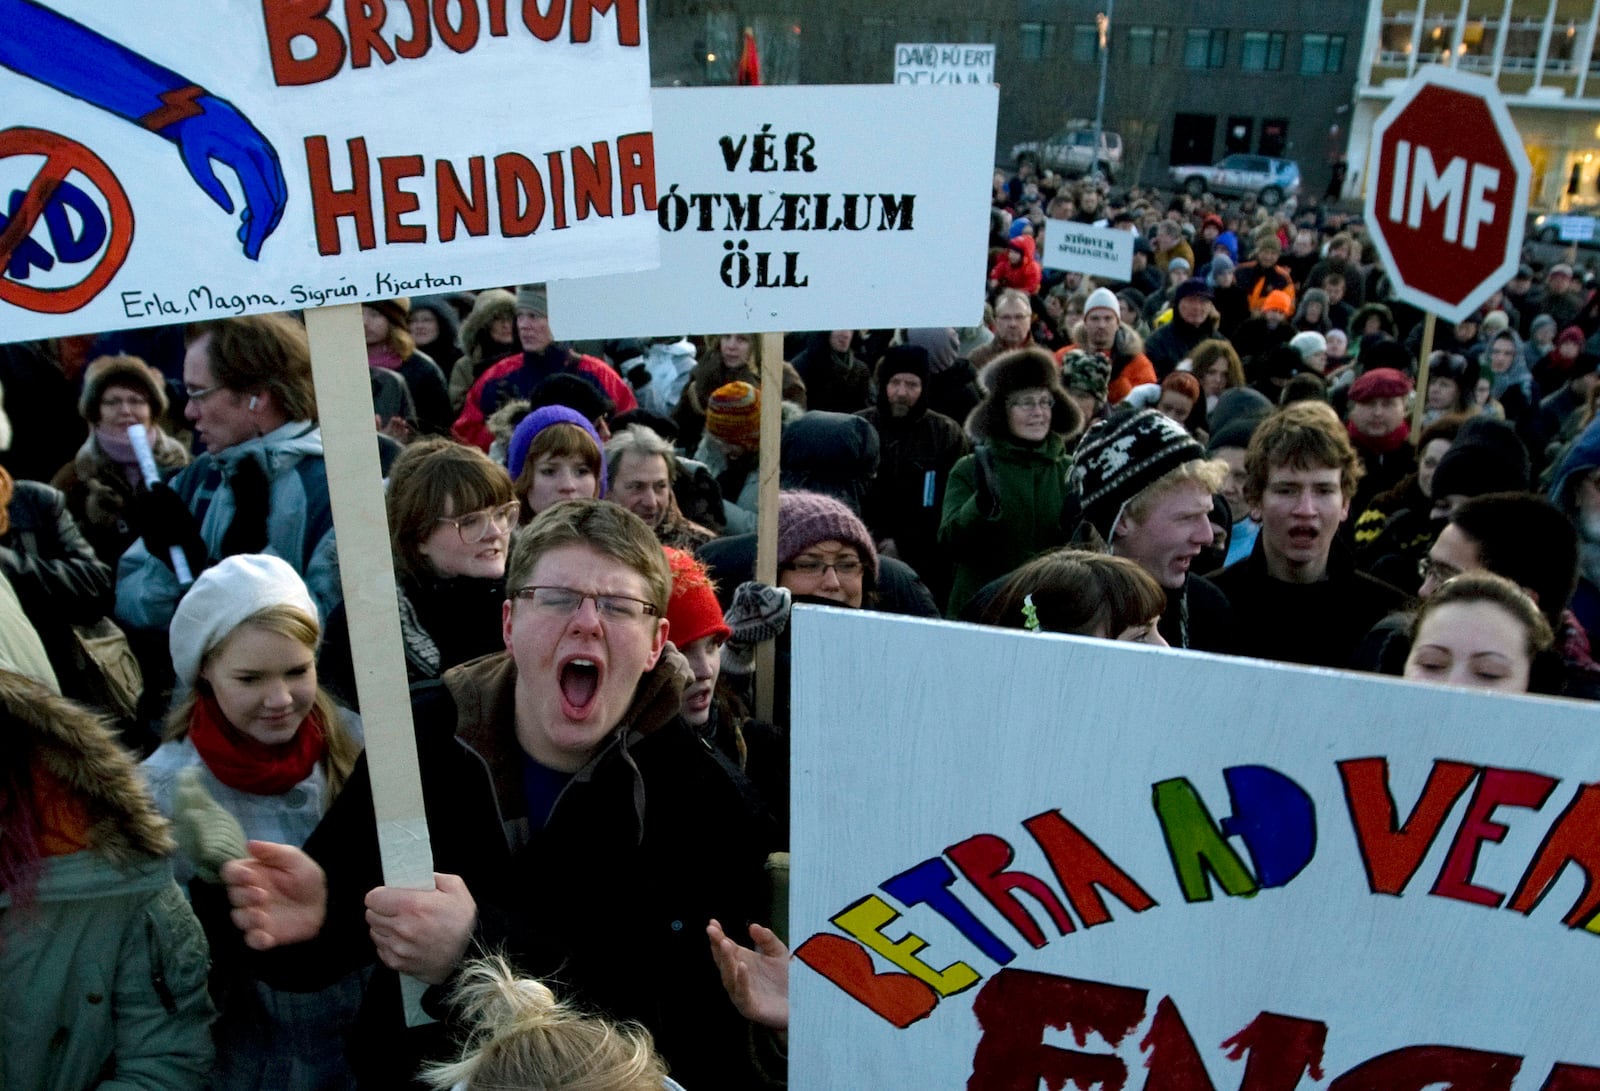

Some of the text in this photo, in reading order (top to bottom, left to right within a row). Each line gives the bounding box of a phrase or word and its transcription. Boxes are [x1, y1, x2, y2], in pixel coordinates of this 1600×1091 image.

[963, 49, 993, 67] ERT
[719, 124, 817, 172] VÉR
[304, 132, 656, 255] HENDINA
[657, 184, 915, 231] ÓTMÆLUM
[1389, 139, 1501, 251] IMF
[719, 239, 808, 289] ÖLL
[121, 290, 189, 318] Erla,
[375, 272, 463, 296] Kjartan
[793, 808, 1160, 1028] BETRA
[1334, 756, 1600, 935] VER
